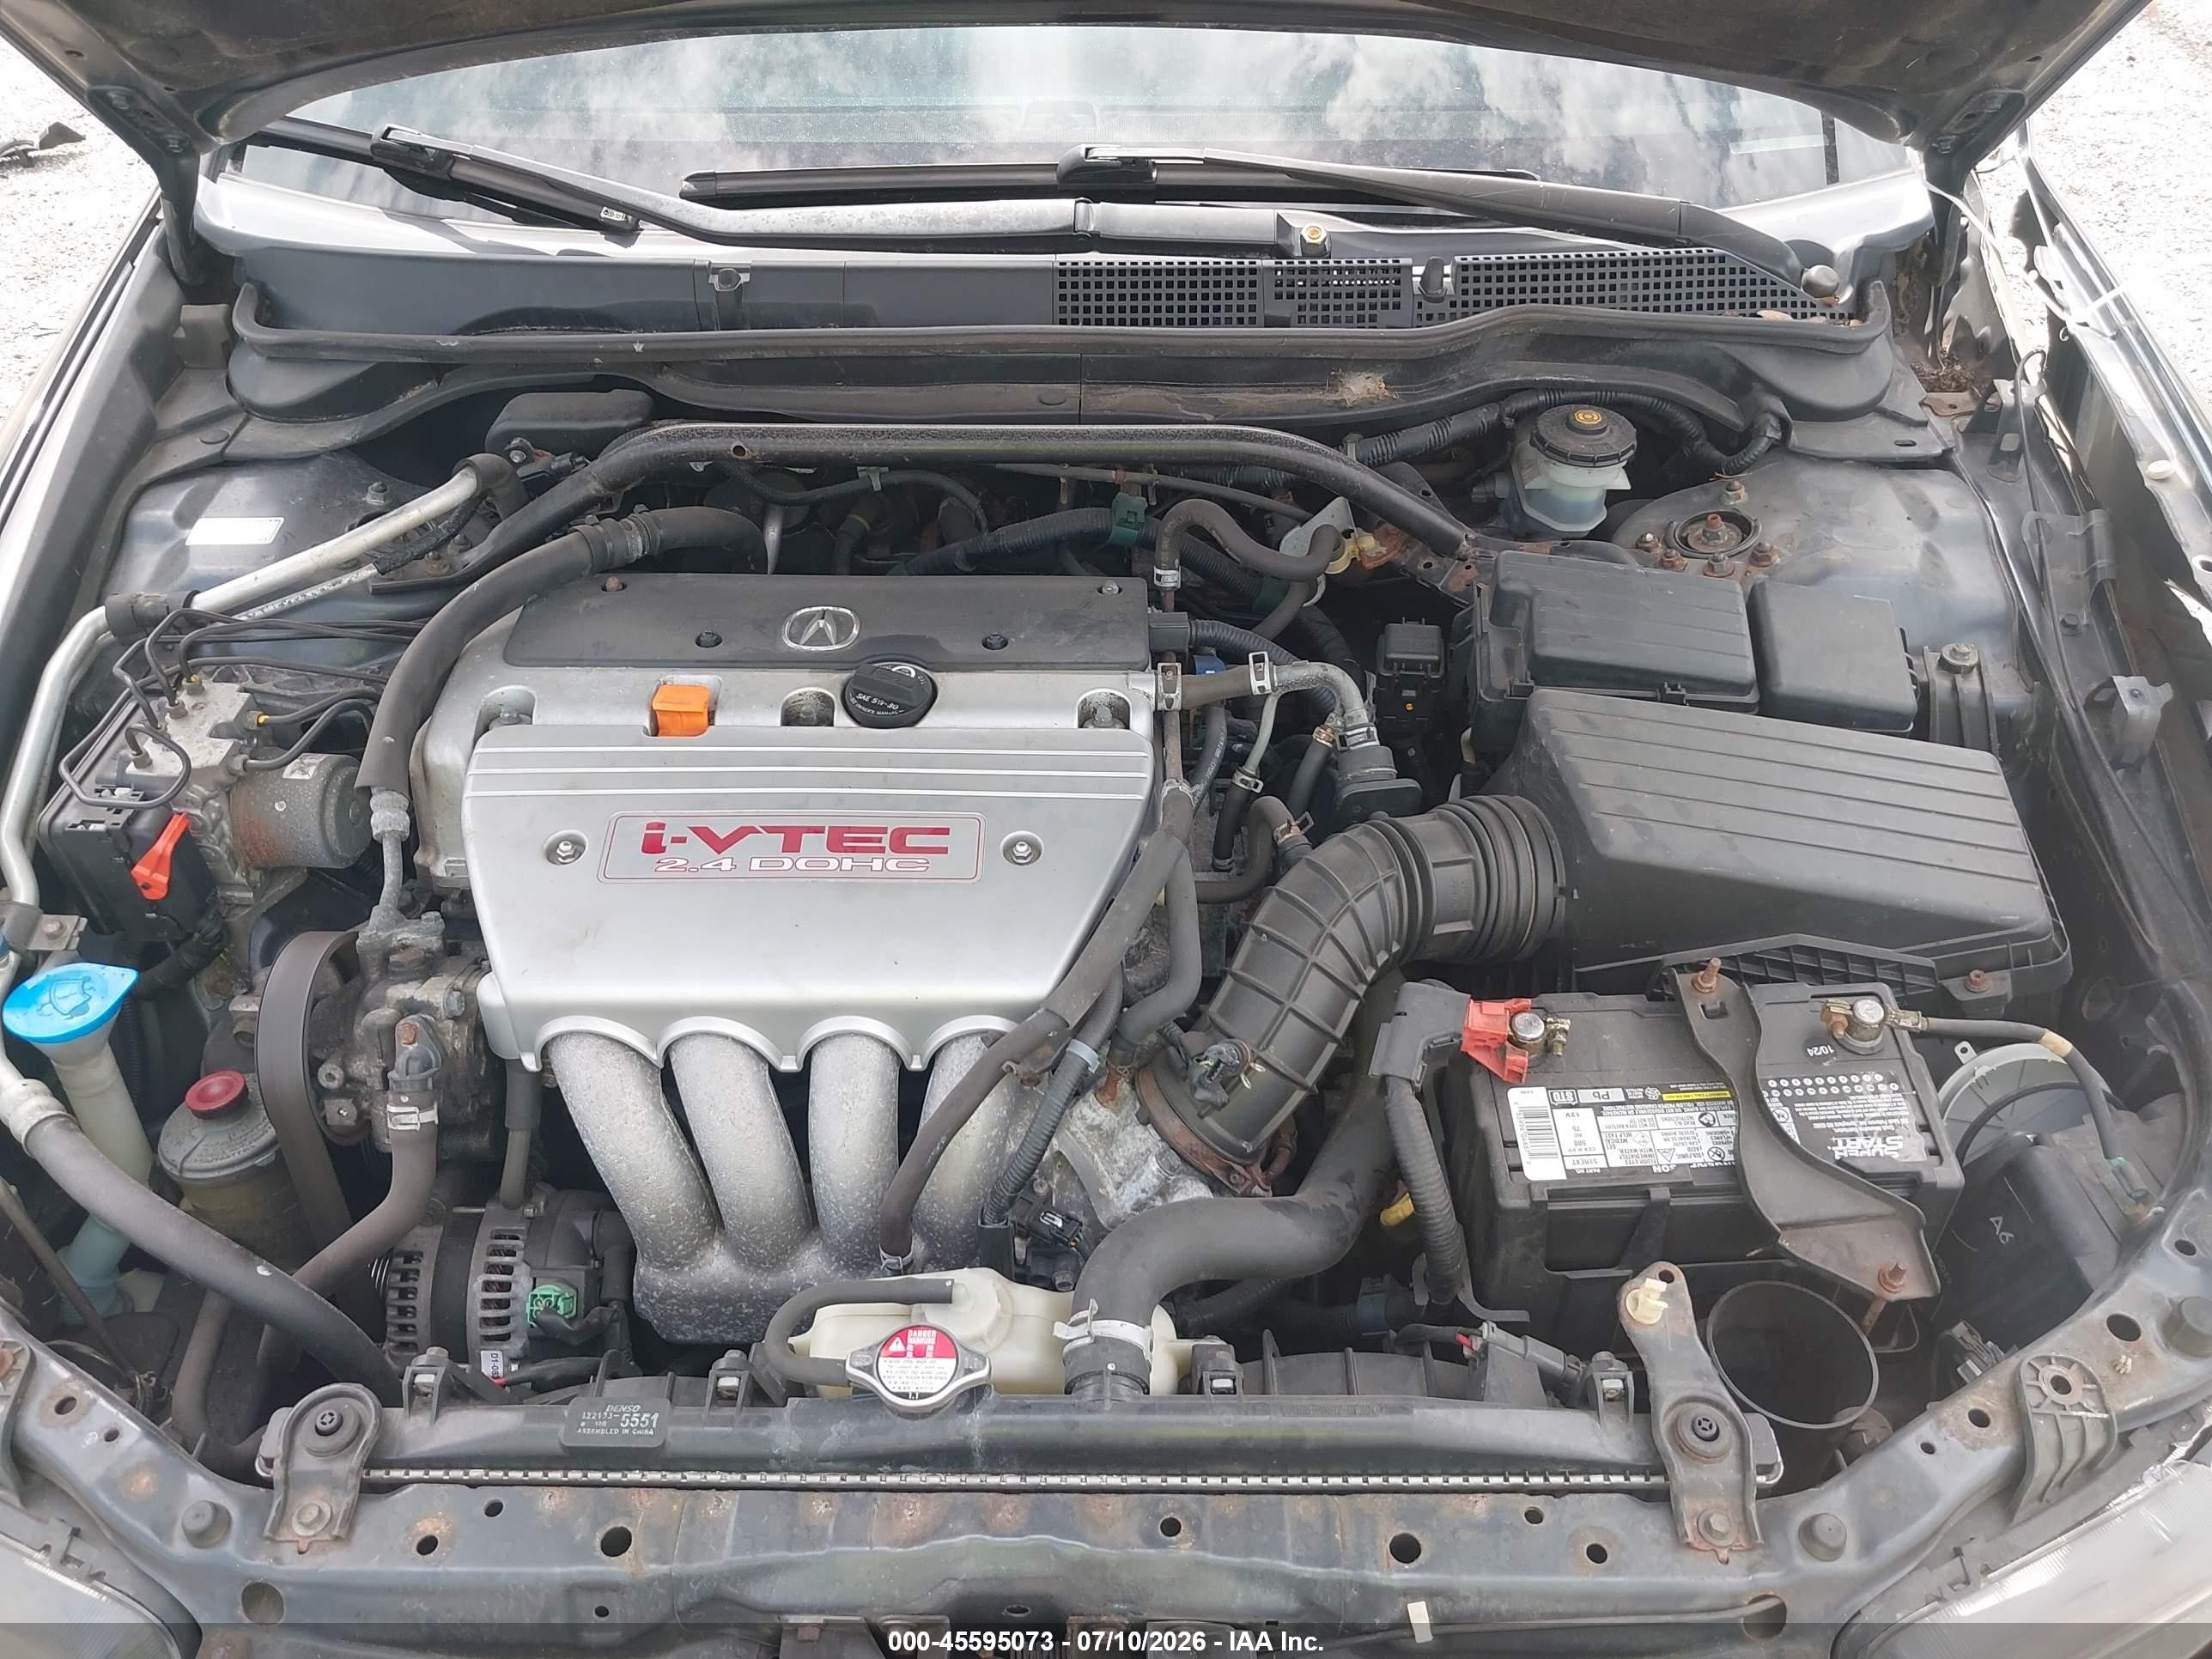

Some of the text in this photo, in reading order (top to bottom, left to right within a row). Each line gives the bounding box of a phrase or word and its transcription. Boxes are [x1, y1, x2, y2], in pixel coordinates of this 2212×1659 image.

[855, 693, 899, 710] SAE 5W-30
[640, 821, 951, 855] i-VTEC
[654, 856, 930, 872] 2.4 DOHC
[1806, 1045, 1835, 1057] 10/24
[1592, 1091, 1610, 1100] Pb
[1834, 1136, 1903, 1151] START
[1834, 1148, 1900, 1159] SUPER
[605, 1404, 641, 1413] DENSO
